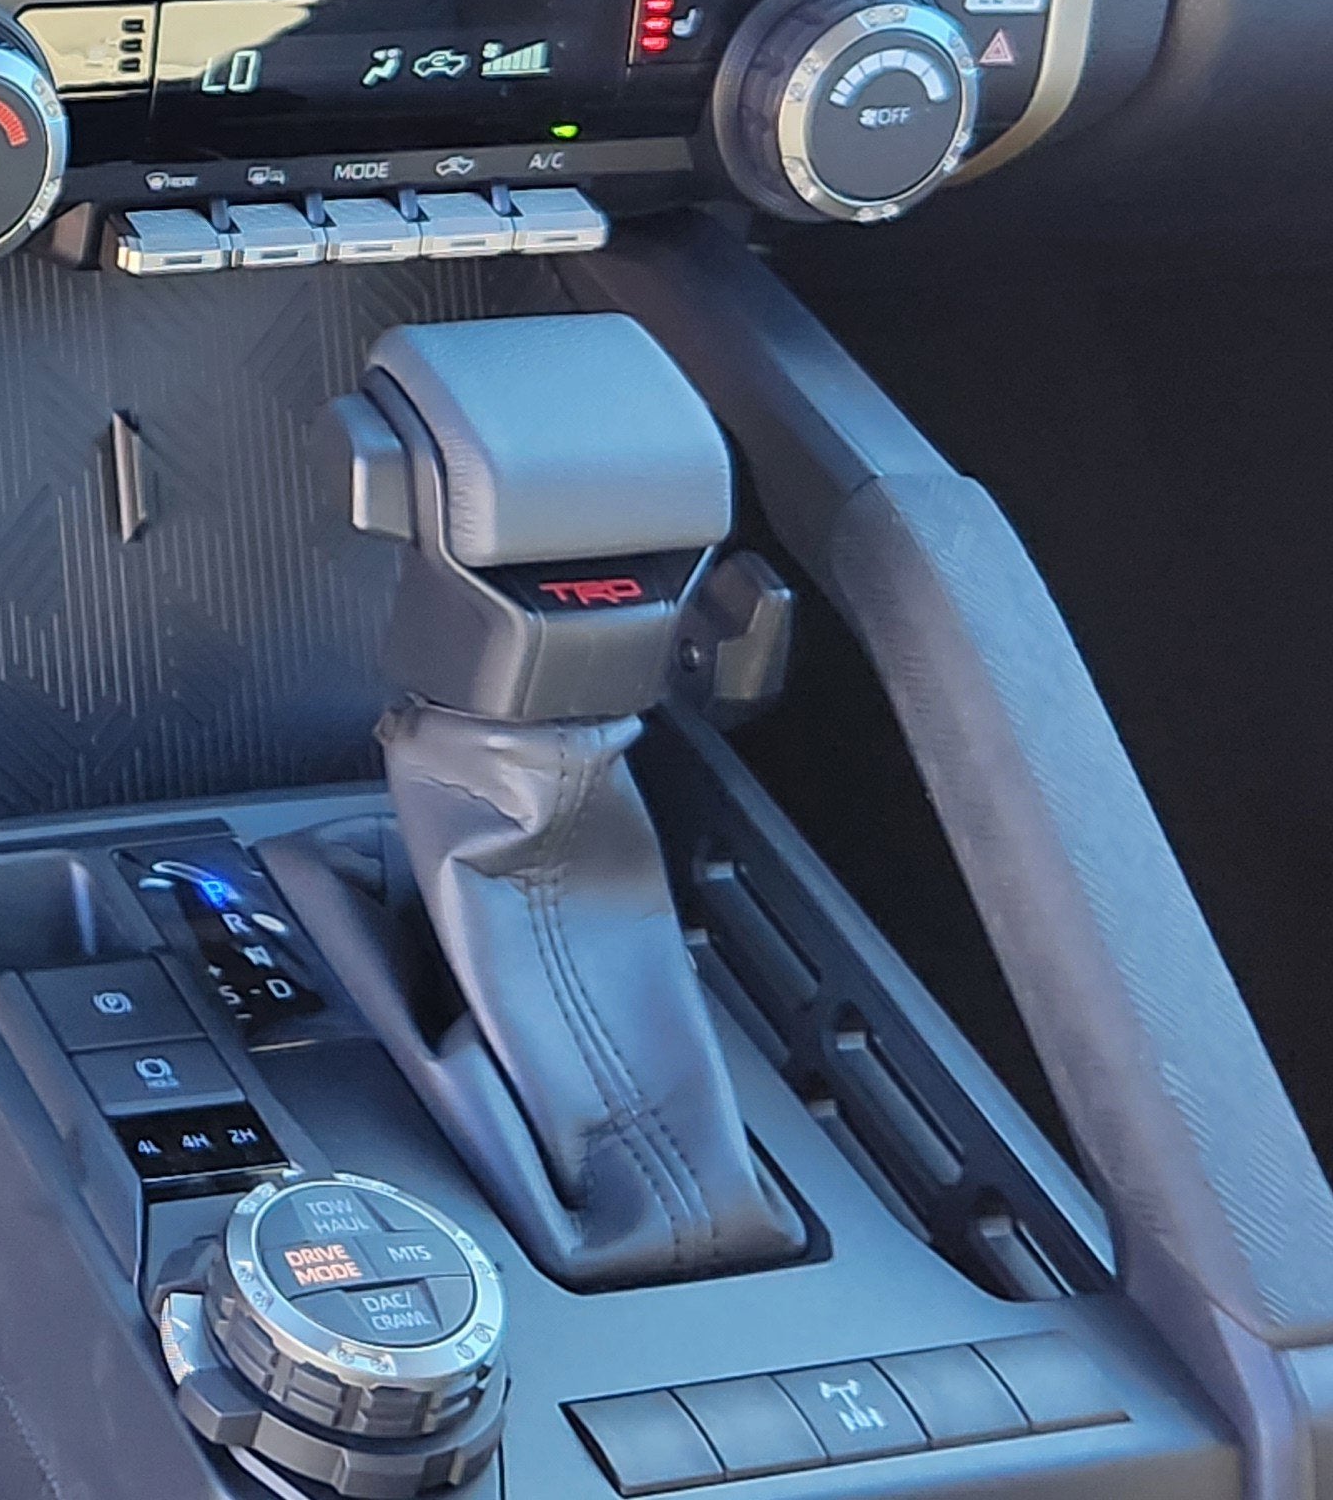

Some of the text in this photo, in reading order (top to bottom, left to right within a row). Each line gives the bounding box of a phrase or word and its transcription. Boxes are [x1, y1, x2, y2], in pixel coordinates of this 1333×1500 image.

[877, 106, 910, 125] OFF
[334, 162, 389, 181] MODE
[528, 151, 565, 172] A/C
[539, 578, 642, 605] TRD
[222, 912, 252, 934] R
[266, 978, 293, 999] D
[137, 1127, 258, 1156] 4L 4H 2H
[306, 1199, 353, 1217] TOW
[315, 1216, 369, 1234] HAUL
[284, 1244, 351, 1267] DRIVE
[388, 1245, 432, 1264] MTS
[294, 1262, 362, 1287] MODE
[371, 1310, 431, 1332] CRAWL
